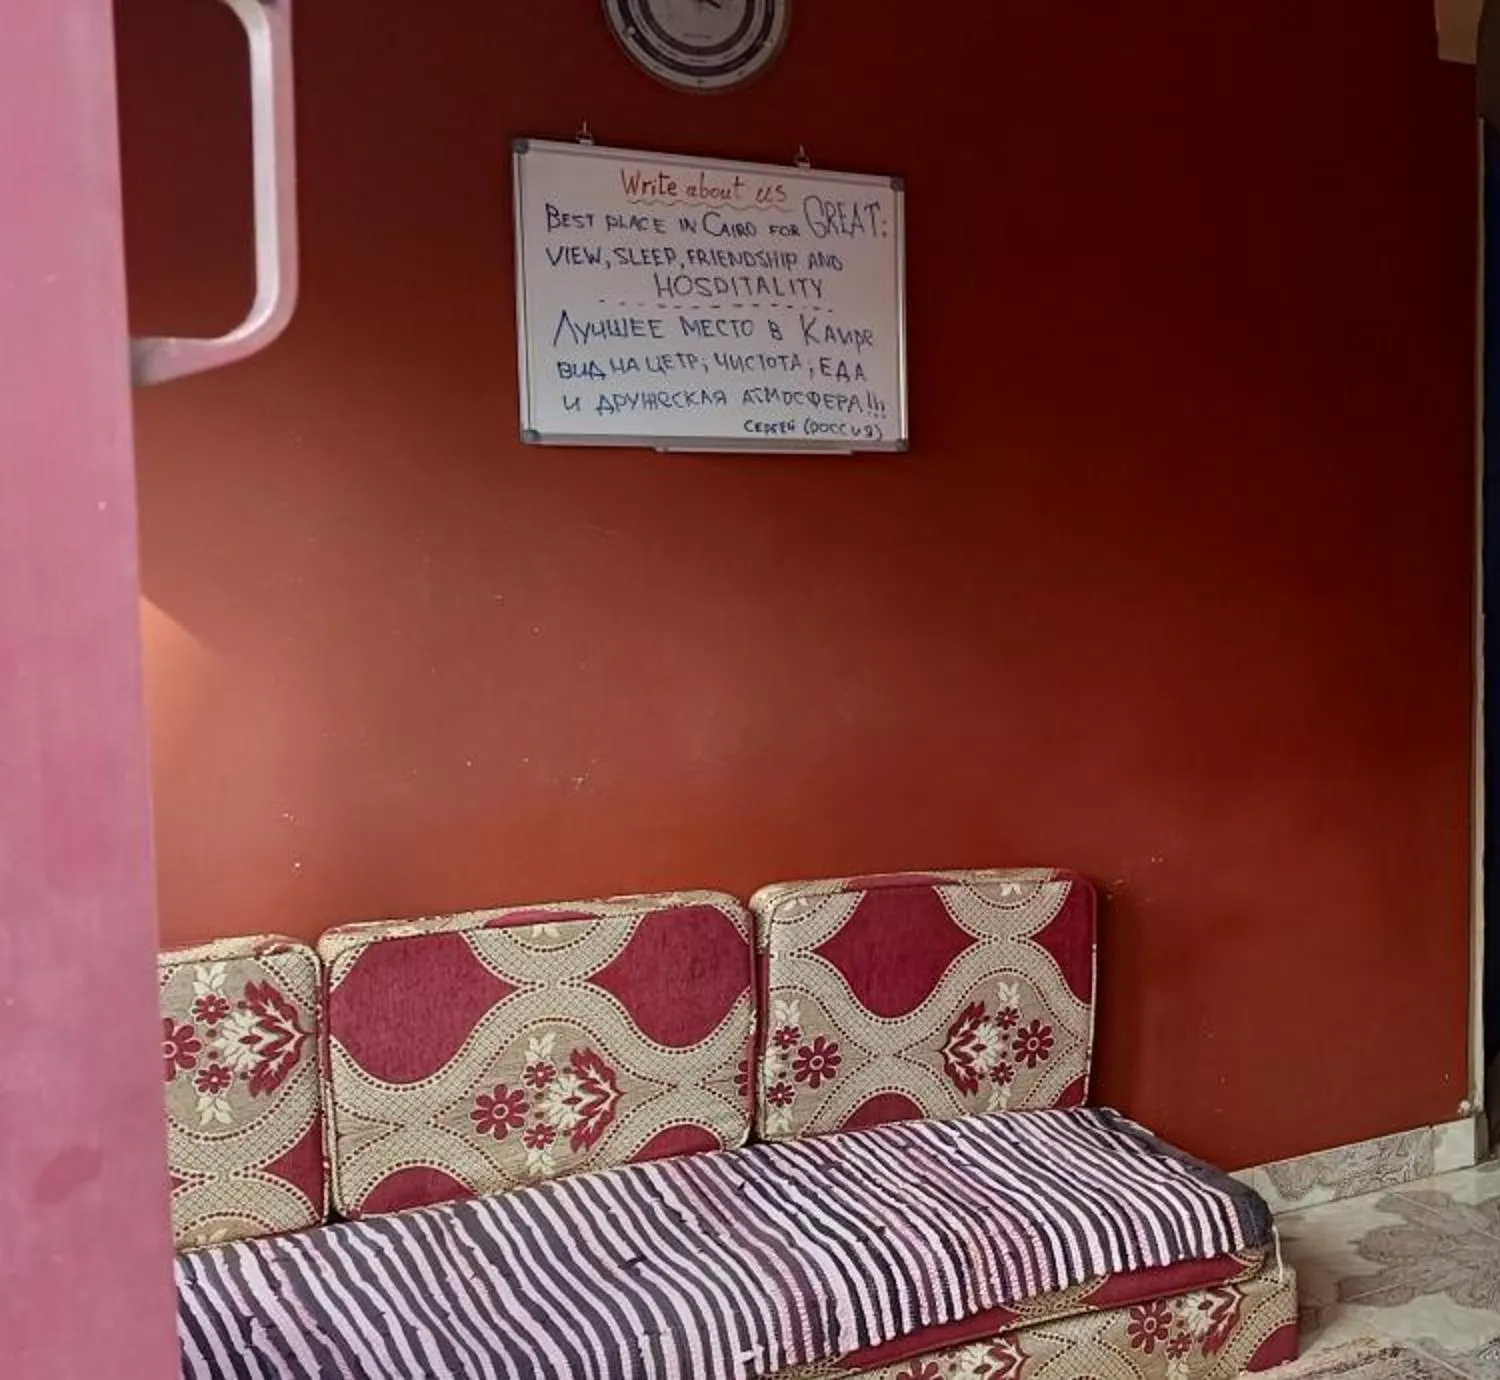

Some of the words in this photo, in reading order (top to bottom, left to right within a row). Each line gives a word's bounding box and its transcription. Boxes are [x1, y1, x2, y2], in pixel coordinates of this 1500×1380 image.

[620, 168, 678, 196] Write
[685, 171, 745, 199] about
[755, 184, 787, 203] us
[605, 213, 668, 235] PLACE
[678, 217, 697, 234] IN
[768, 223, 800, 237] FOR
[802, 195, 887, 239] GREAT:
[686, 248, 798, 272] FRIENDSHIP
[808, 251, 844, 271] AND
[679, 315, 754, 338] МЕСТО
[767, 319, 784, 341] В
[556, 359, 608, 381] ВИД
[609, 357, 641, 374] НА
[819, 356, 867, 383] ЕДА
[563, 394, 581, 412] И
